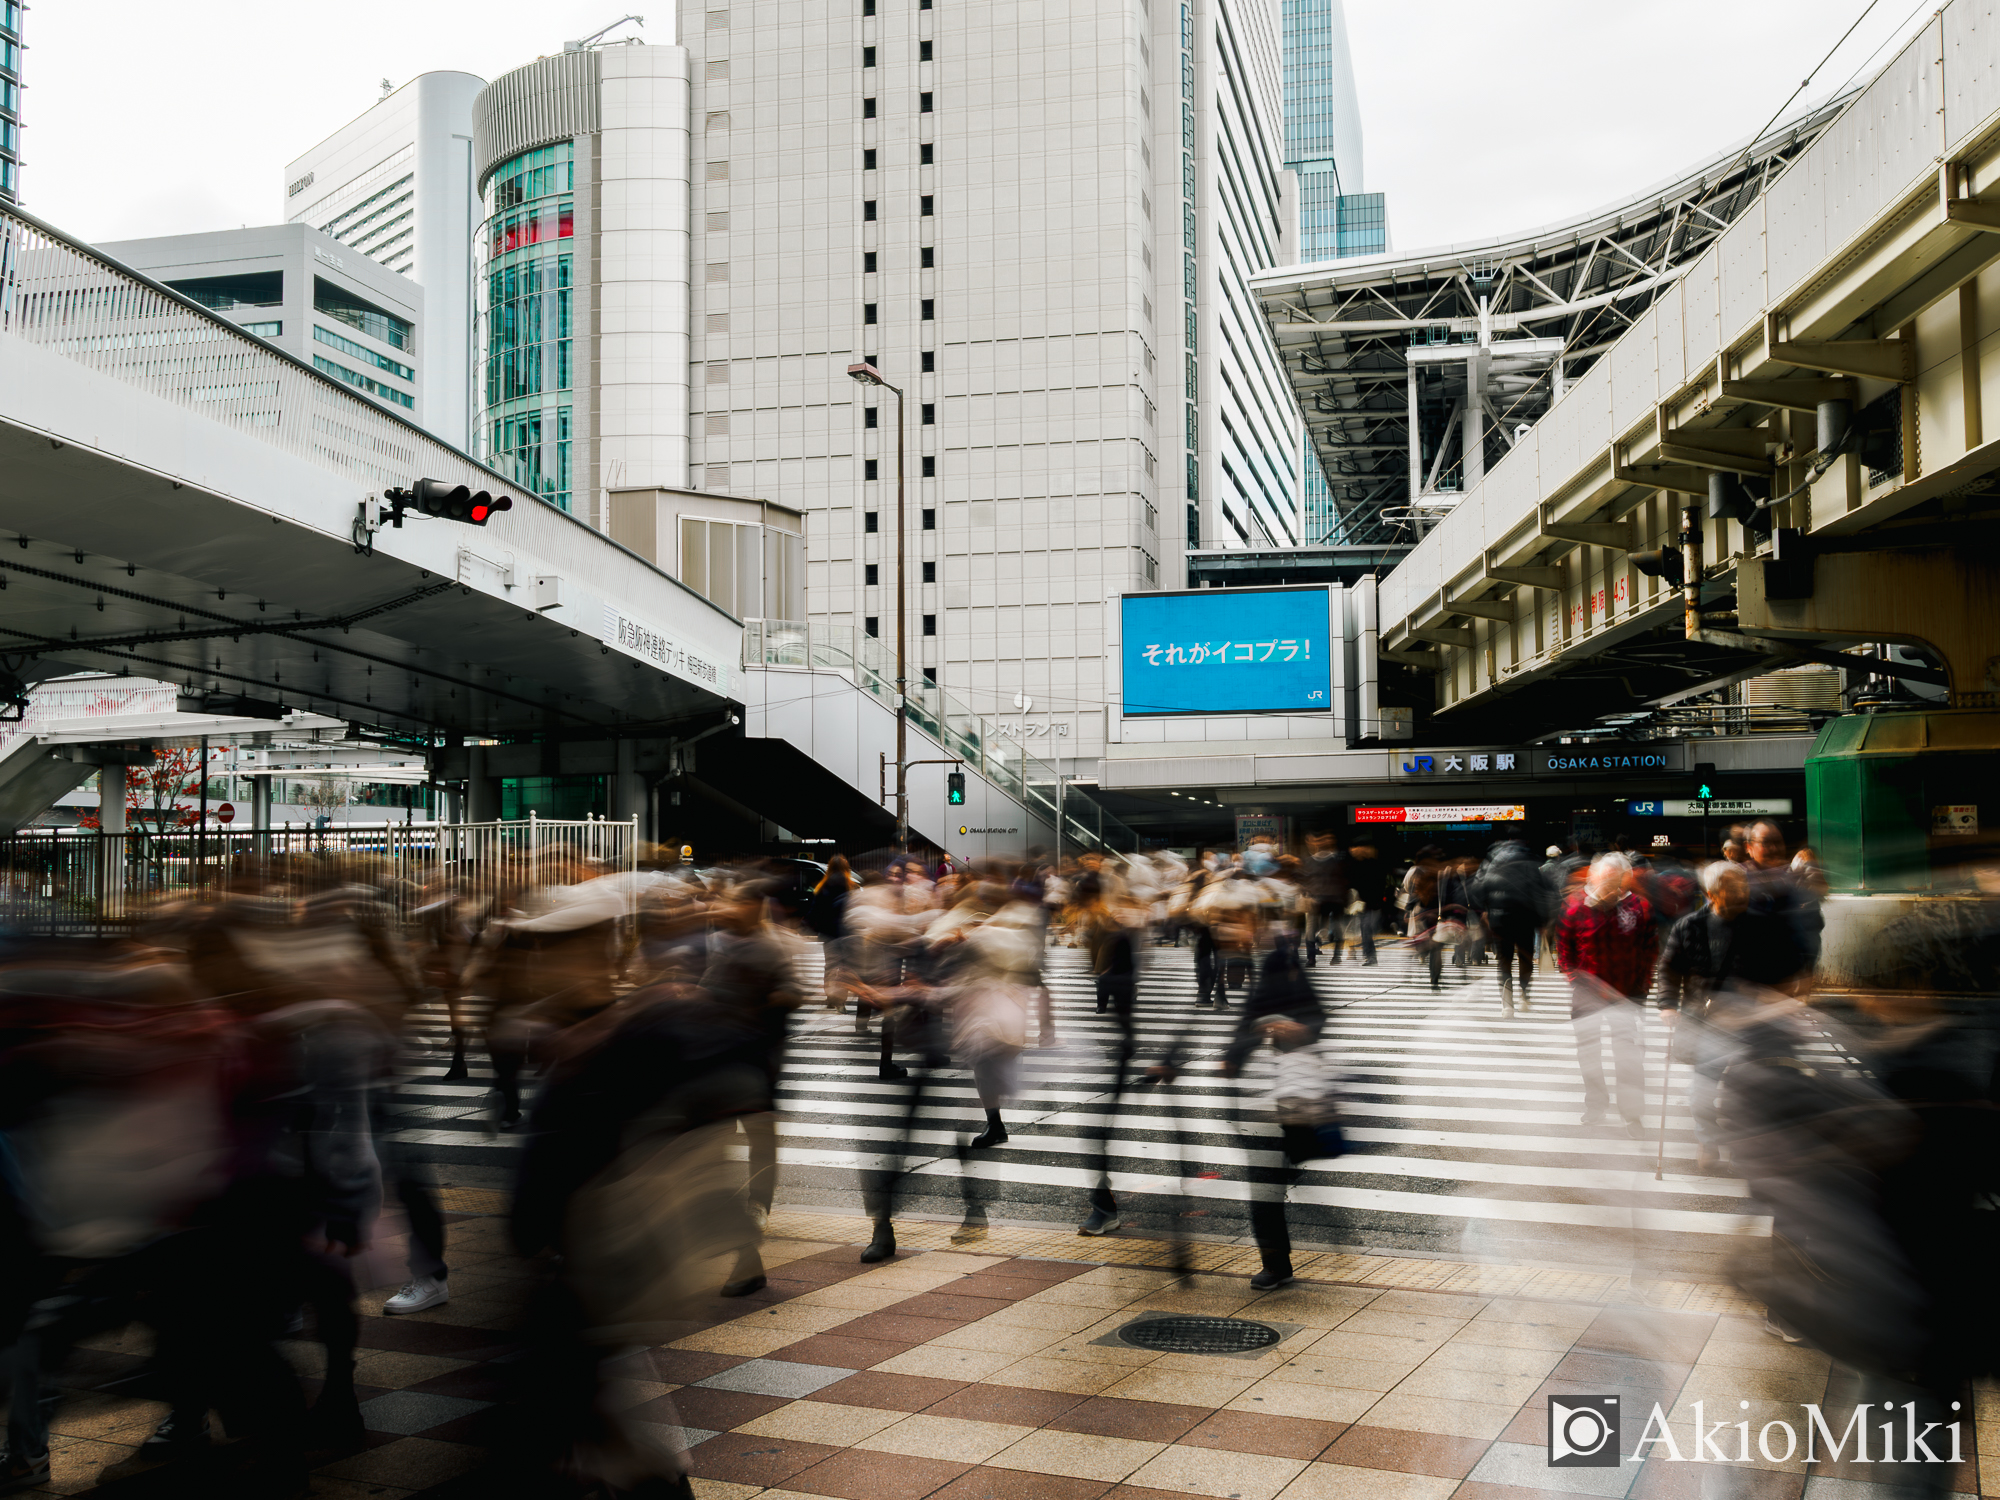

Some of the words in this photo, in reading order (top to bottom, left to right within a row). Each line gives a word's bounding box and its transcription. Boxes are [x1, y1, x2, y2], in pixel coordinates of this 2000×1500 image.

[618, 616, 685, 671] 阪急阪神連絡デッキ
[1307, 690, 1322, 699] JR
[984, 720, 1069, 738] レストラン街
[1402, 755, 1434, 773] JR
[1444, 754, 1516, 772] 大阪駅
[1603, 755, 1667, 769] STATION
[1635, 801, 1655, 812] JR
[1653, 834, 1669, 843] 551
